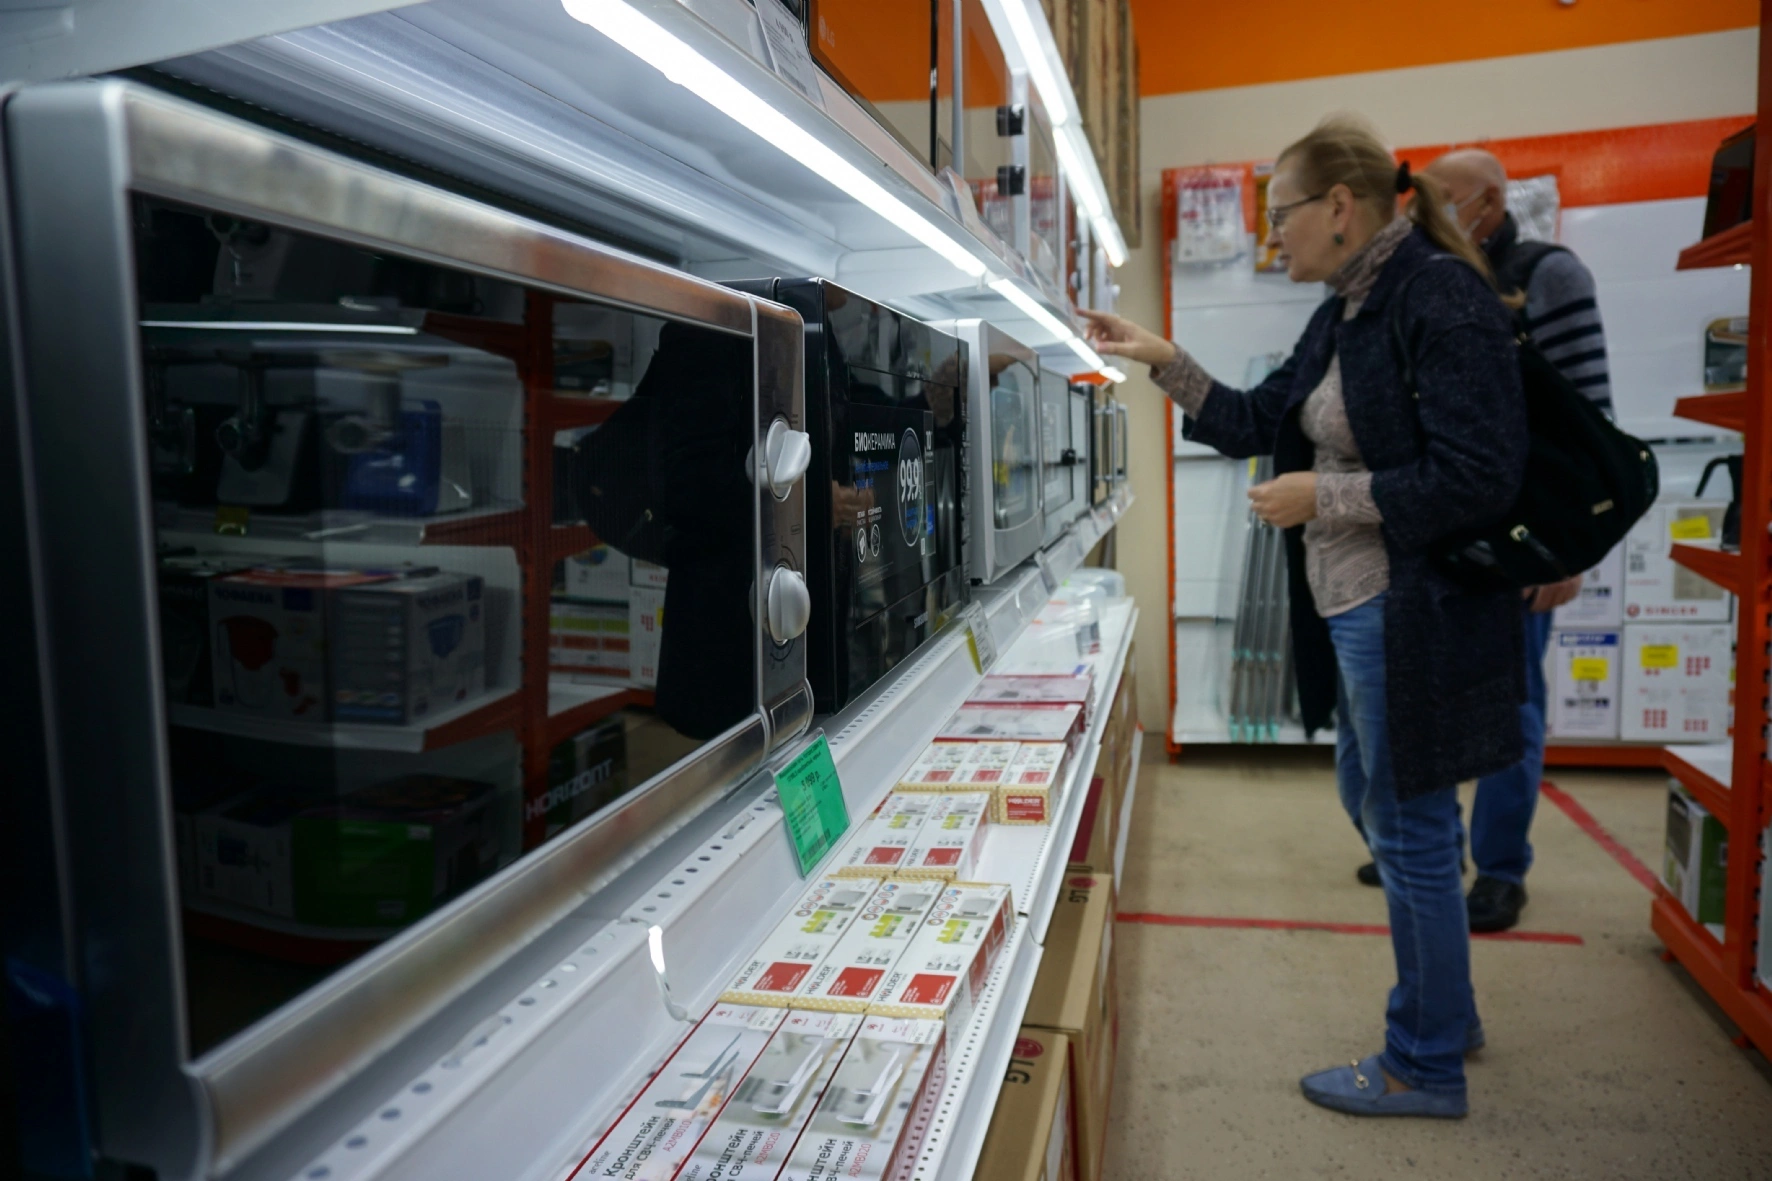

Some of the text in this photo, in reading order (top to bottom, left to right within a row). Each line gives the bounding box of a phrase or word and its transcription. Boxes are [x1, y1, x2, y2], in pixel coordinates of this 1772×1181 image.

[854, 431, 896, 452] БИОКЕРАМИКА
[732, 960, 759, 989] HOLDER
[805, 966, 832, 994] HOLDER
[878, 972, 901, 1001] HOLDER
[1003, 1059, 1035, 1085] LG
[602, 1115, 660, 1177] Кронштейн
[624, 1117, 676, 1180] для СВЧ-печей
[729, 1130, 764, 1177] СВЧ-печей
